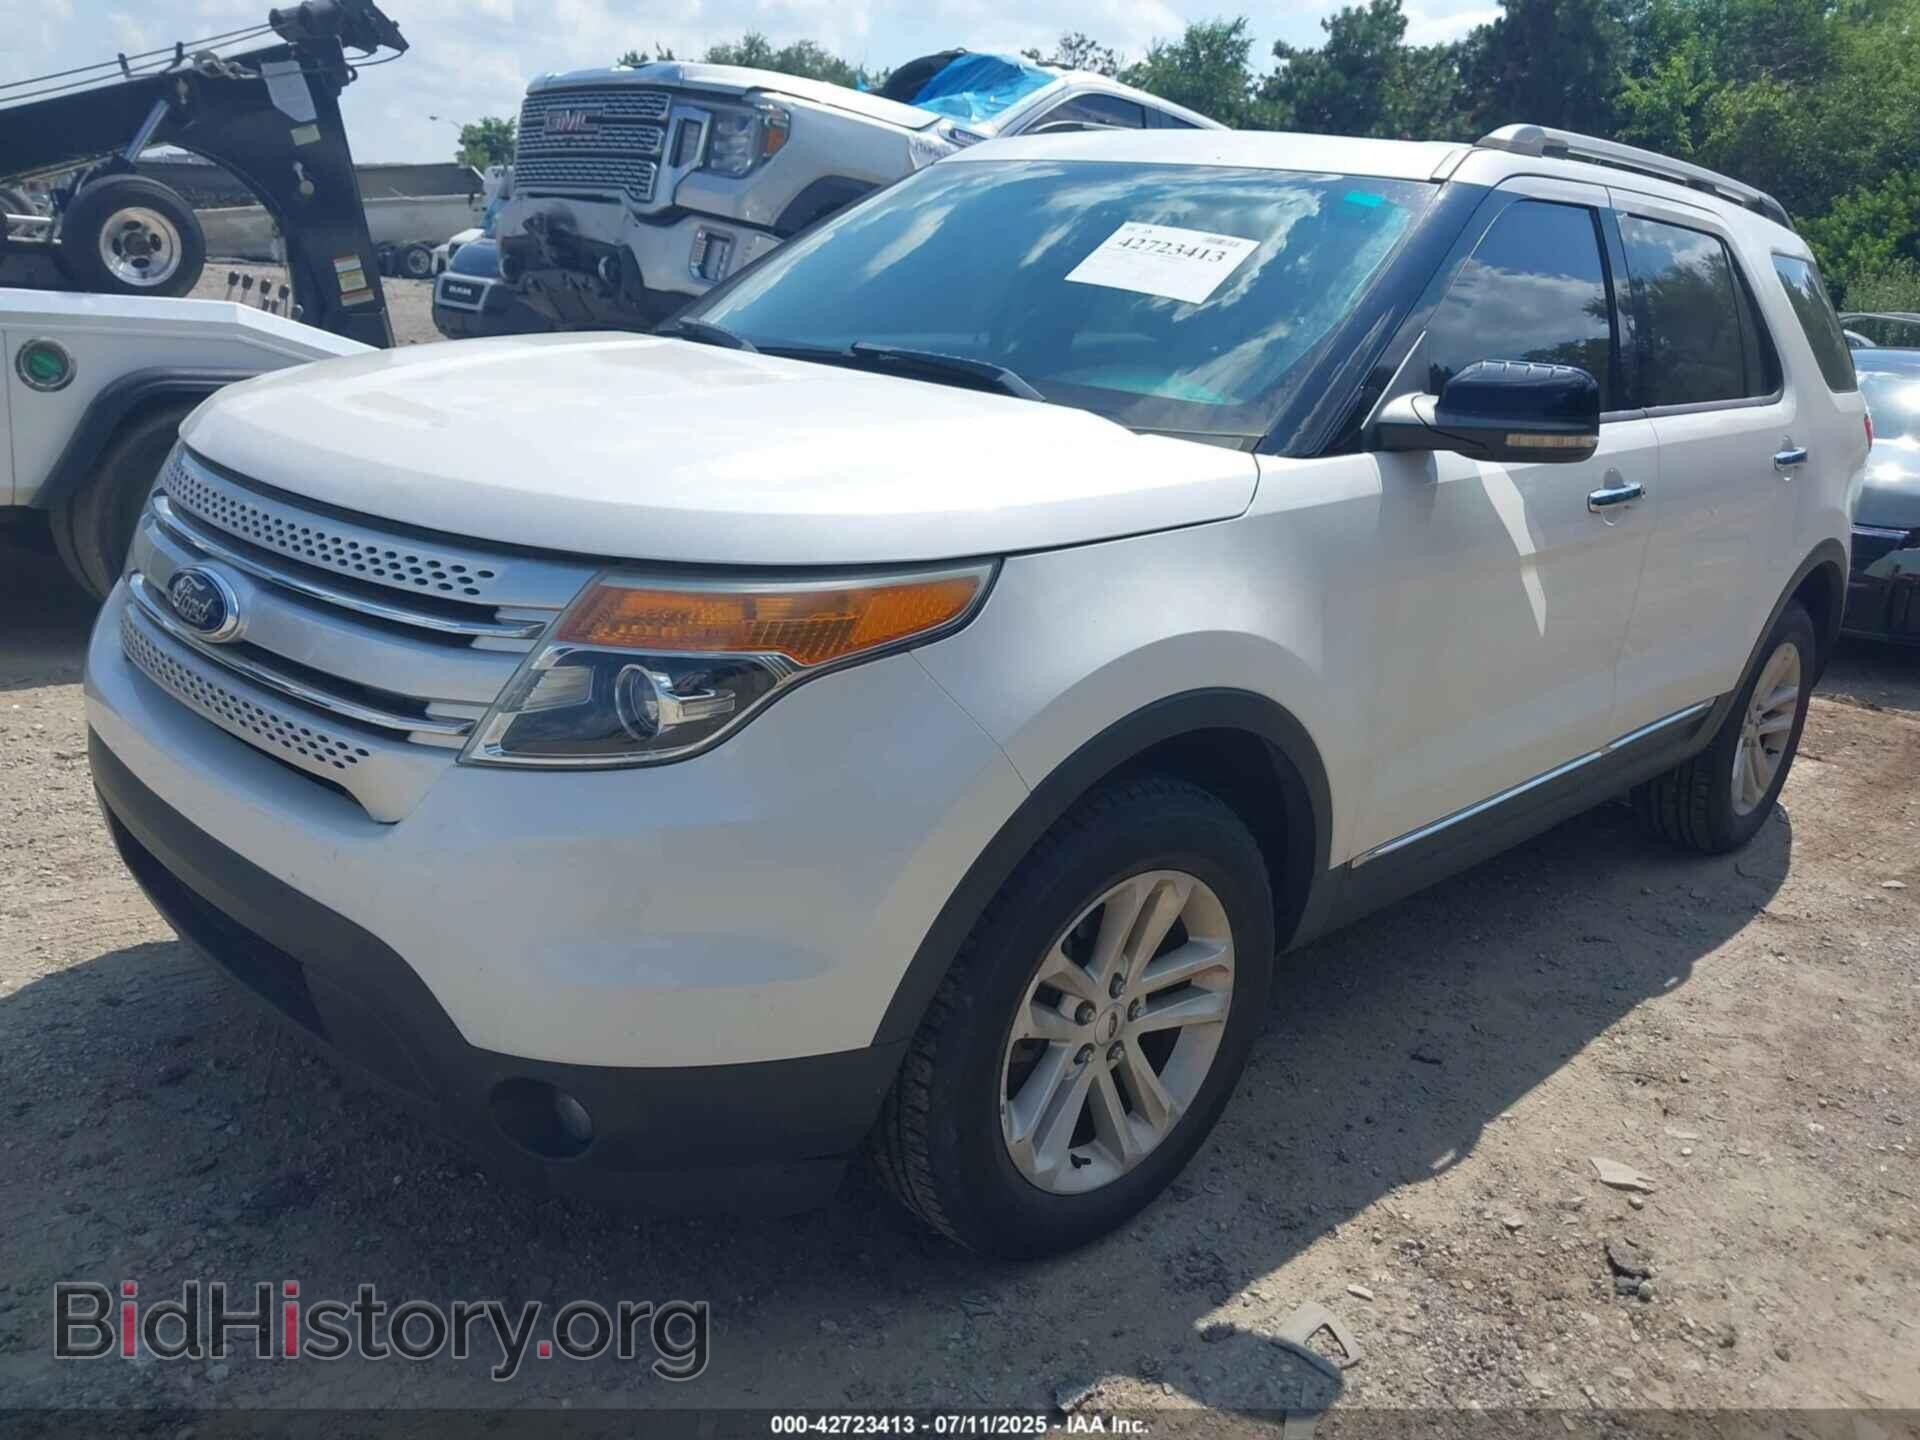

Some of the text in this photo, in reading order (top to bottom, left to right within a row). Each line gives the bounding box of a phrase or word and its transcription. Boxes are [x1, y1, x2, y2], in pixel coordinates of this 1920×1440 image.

[544, 110, 601, 133] GMC
[1118, 237, 1227, 262] 42723413
[171, 575, 213, 622] Ford
